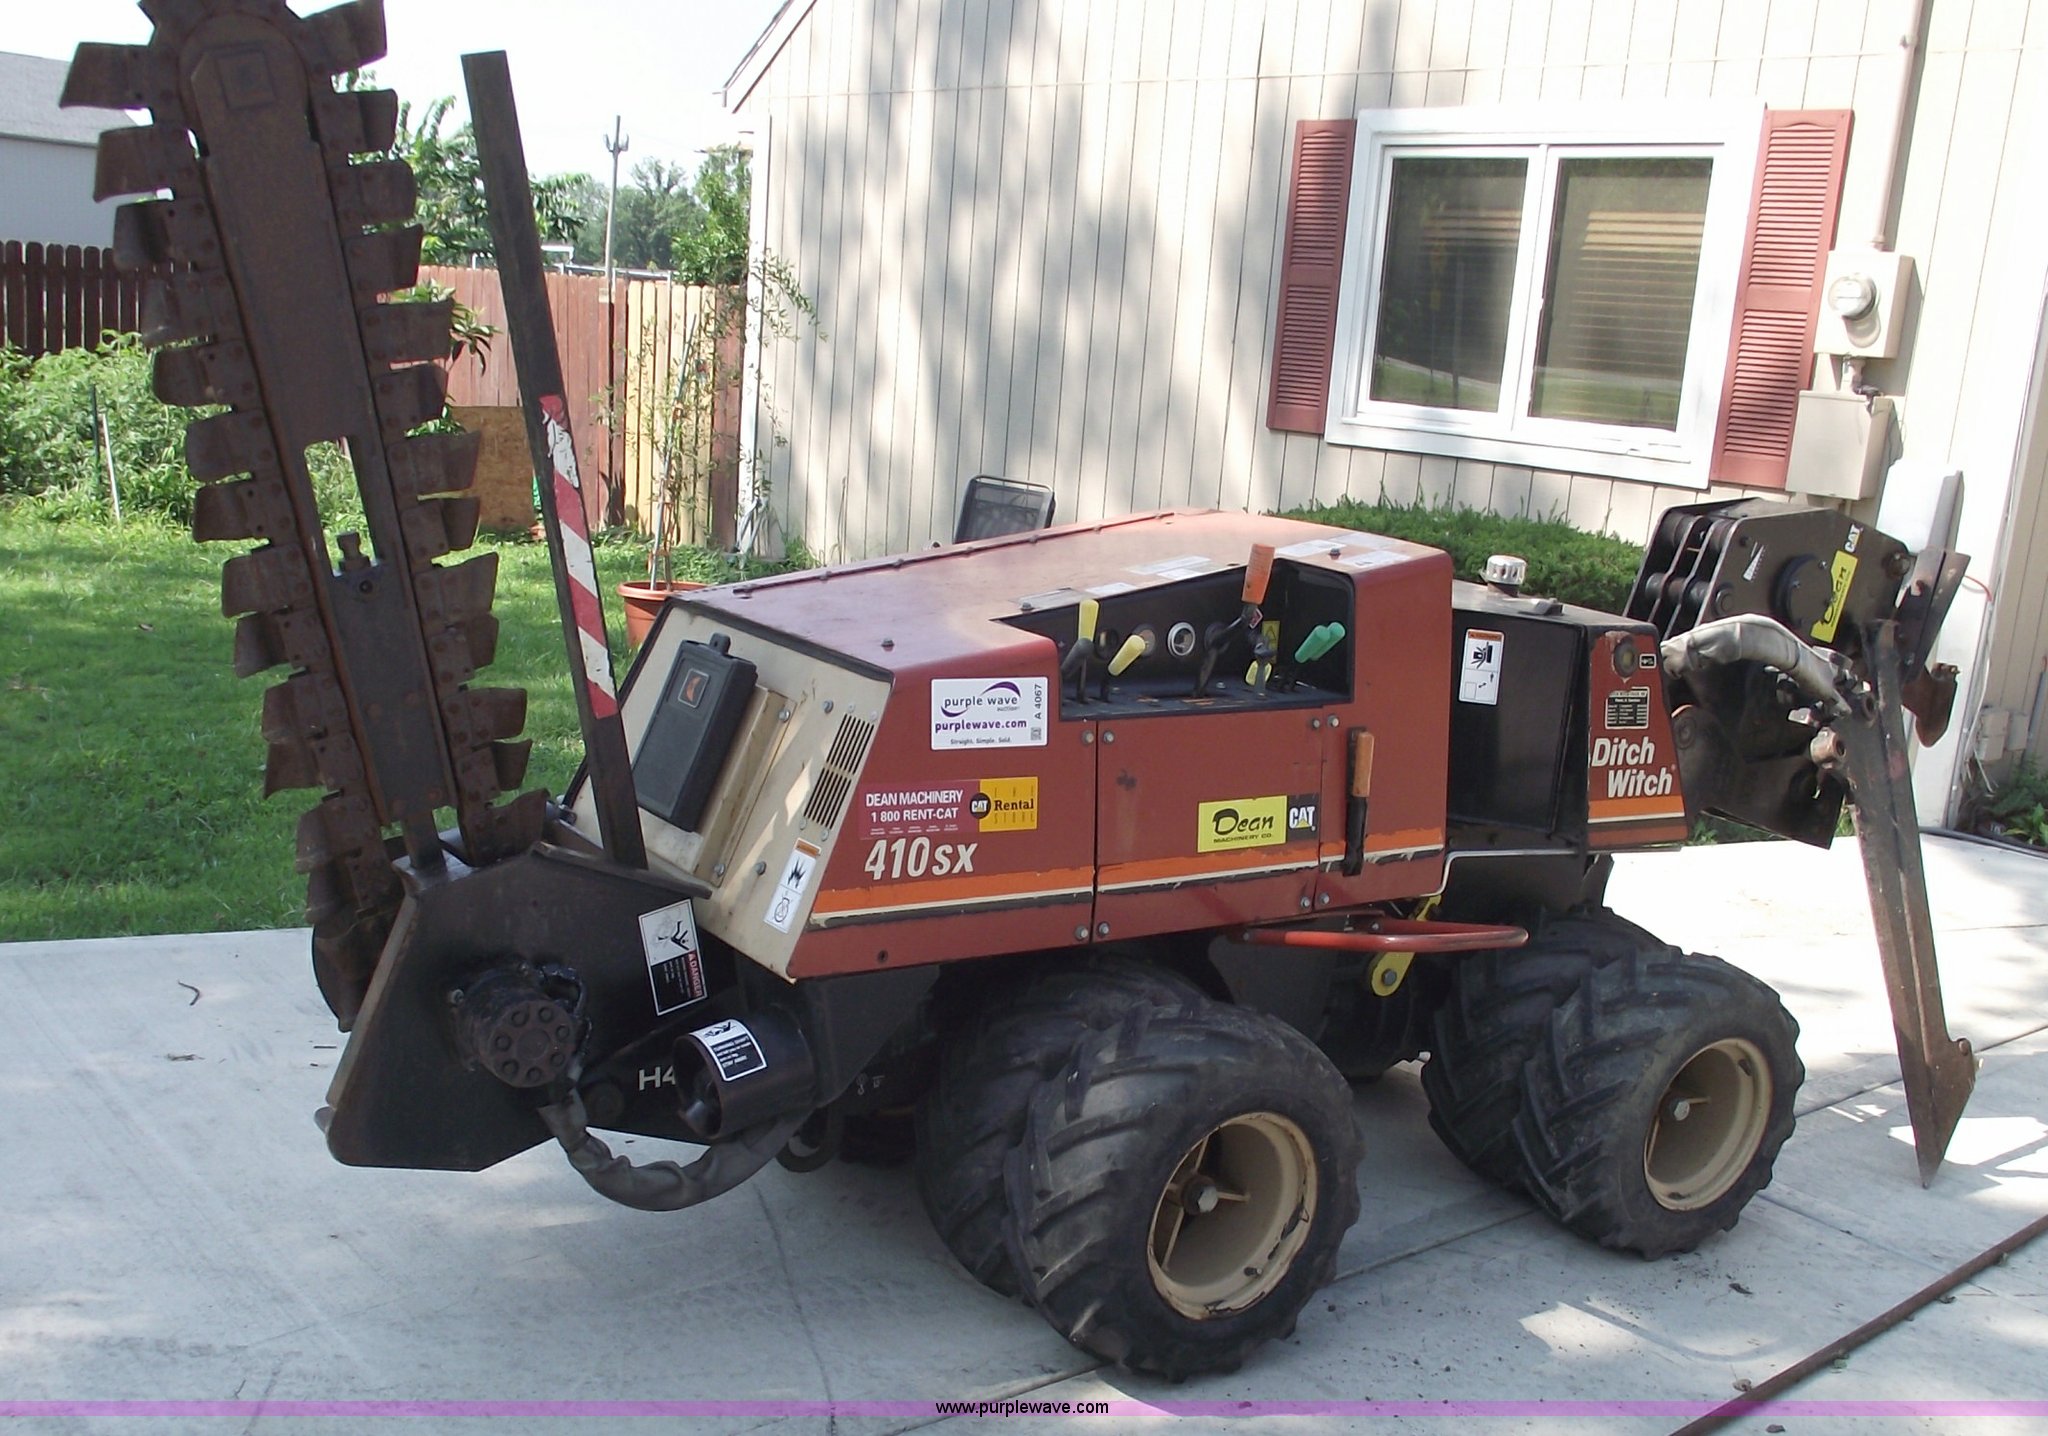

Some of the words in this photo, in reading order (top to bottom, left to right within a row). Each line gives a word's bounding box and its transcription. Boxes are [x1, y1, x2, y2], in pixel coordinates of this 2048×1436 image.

[1844, 524, 1860, 553] CAT
[944, 696, 983, 708] purple
[987, 696, 1018, 706] wave
[1034, 684, 1042, 709] 4067
[1034, 712, 1042, 720] A
[935, 719, 1027, 734] purplewave.com
[1591, 736, 1655, 767] Ditch
[1608, 767, 1673, 798] Witch
[865, 792, 898, 807] DEAN
[899, 789, 964, 806] MACHINERY
[971, 800, 988, 813] CAT
[994, 798, 1034, 811] Rental
[871, 812, 877, 823] 1
[880, 810, 900, 822] 800
[903, 807, 959, 821] RENT-CAT
[1213, 808, 1274, 836] Dean
[1289, 806, 1316, 829] CAT
[1213, 834, 1259, 843] MACHINERY
[689, 960, 703, 998] DANGER
